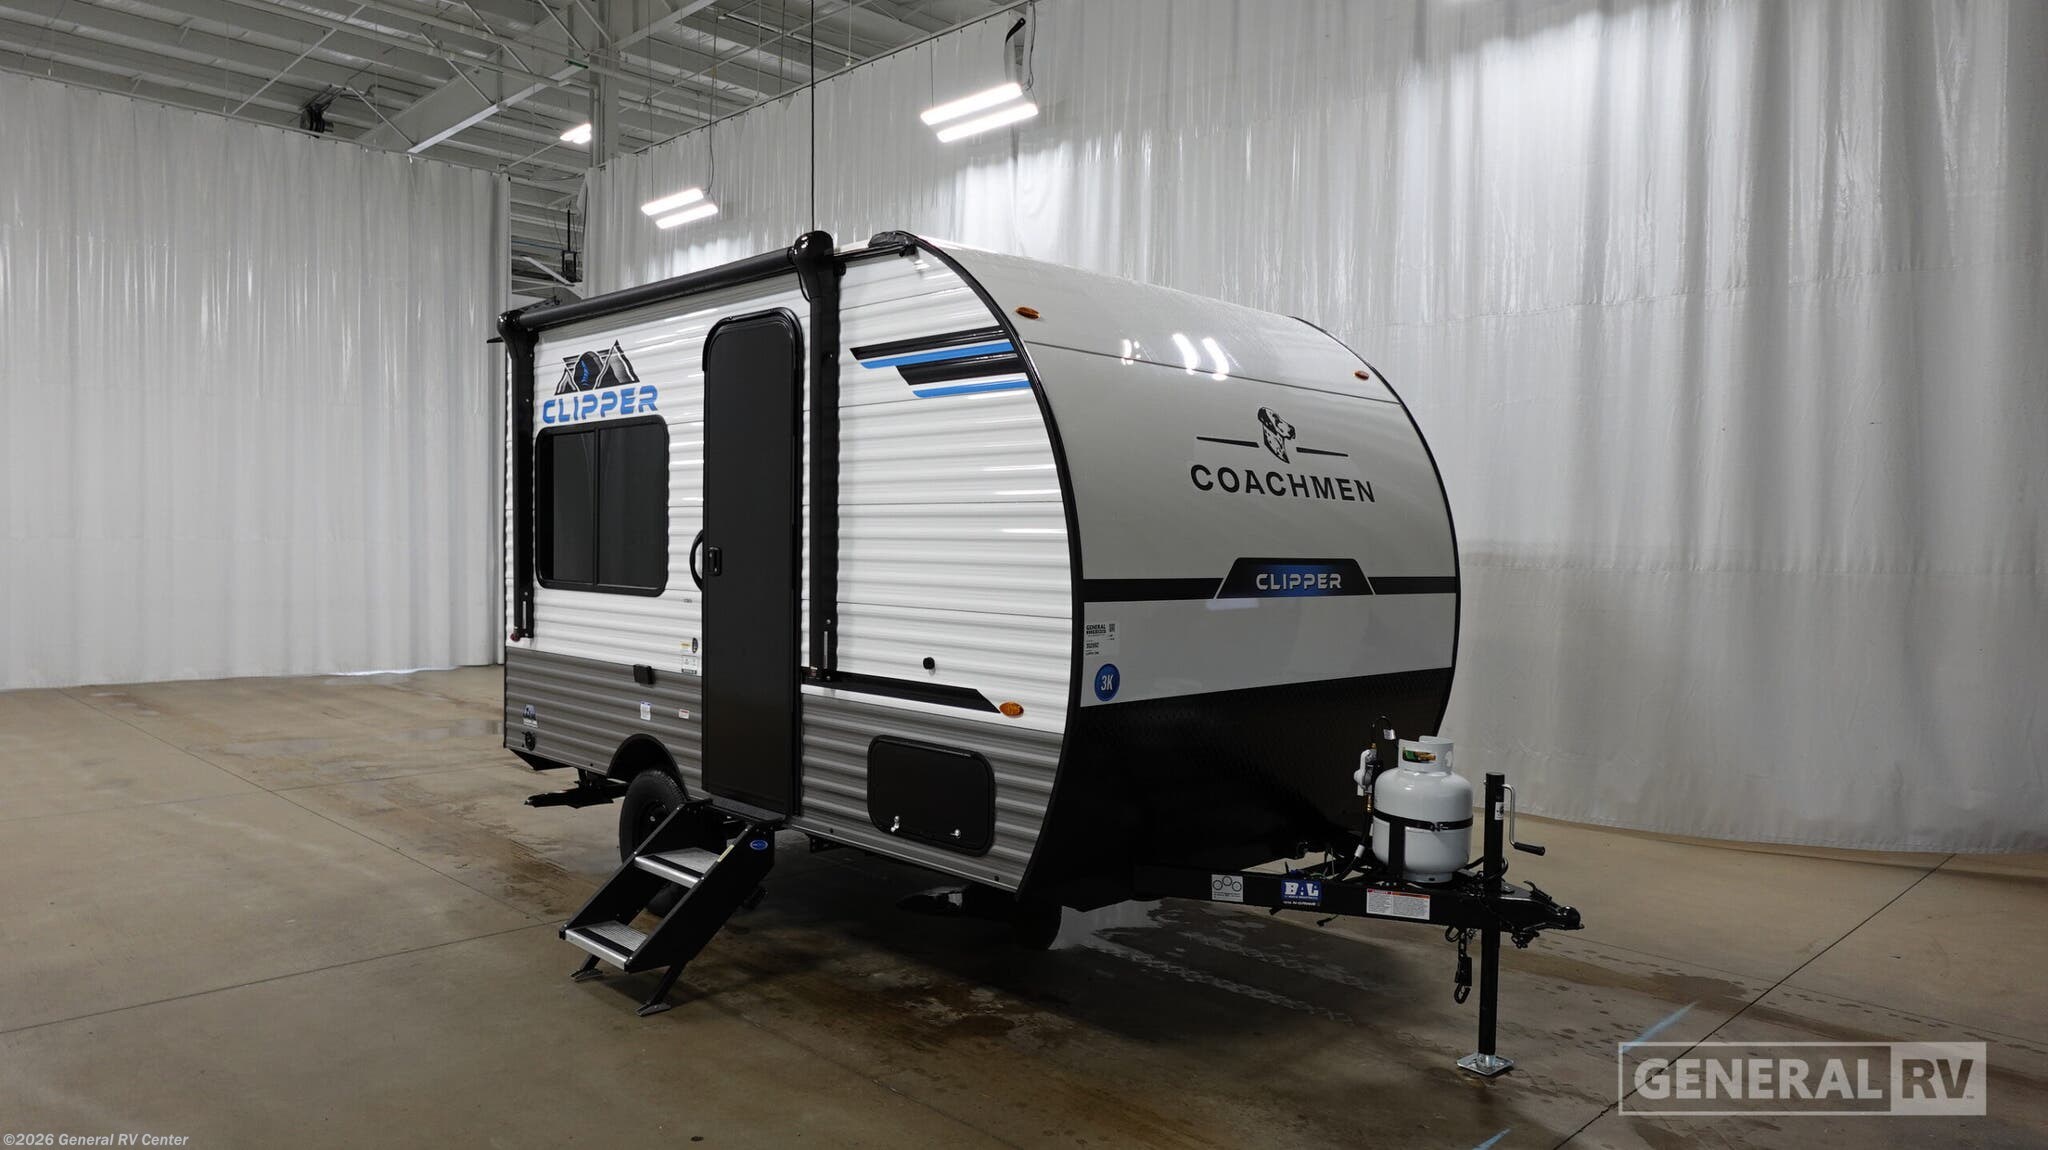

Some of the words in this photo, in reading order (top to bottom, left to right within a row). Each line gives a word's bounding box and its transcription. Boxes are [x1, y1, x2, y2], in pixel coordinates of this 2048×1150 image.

[542, 384, 658, 424] CLIPPER
[1190, 464, 1376, 503] COACHMEN
[1255, 573, 1343, 590] CLIPPER
[1101, 674, 1114, 691] 3K
